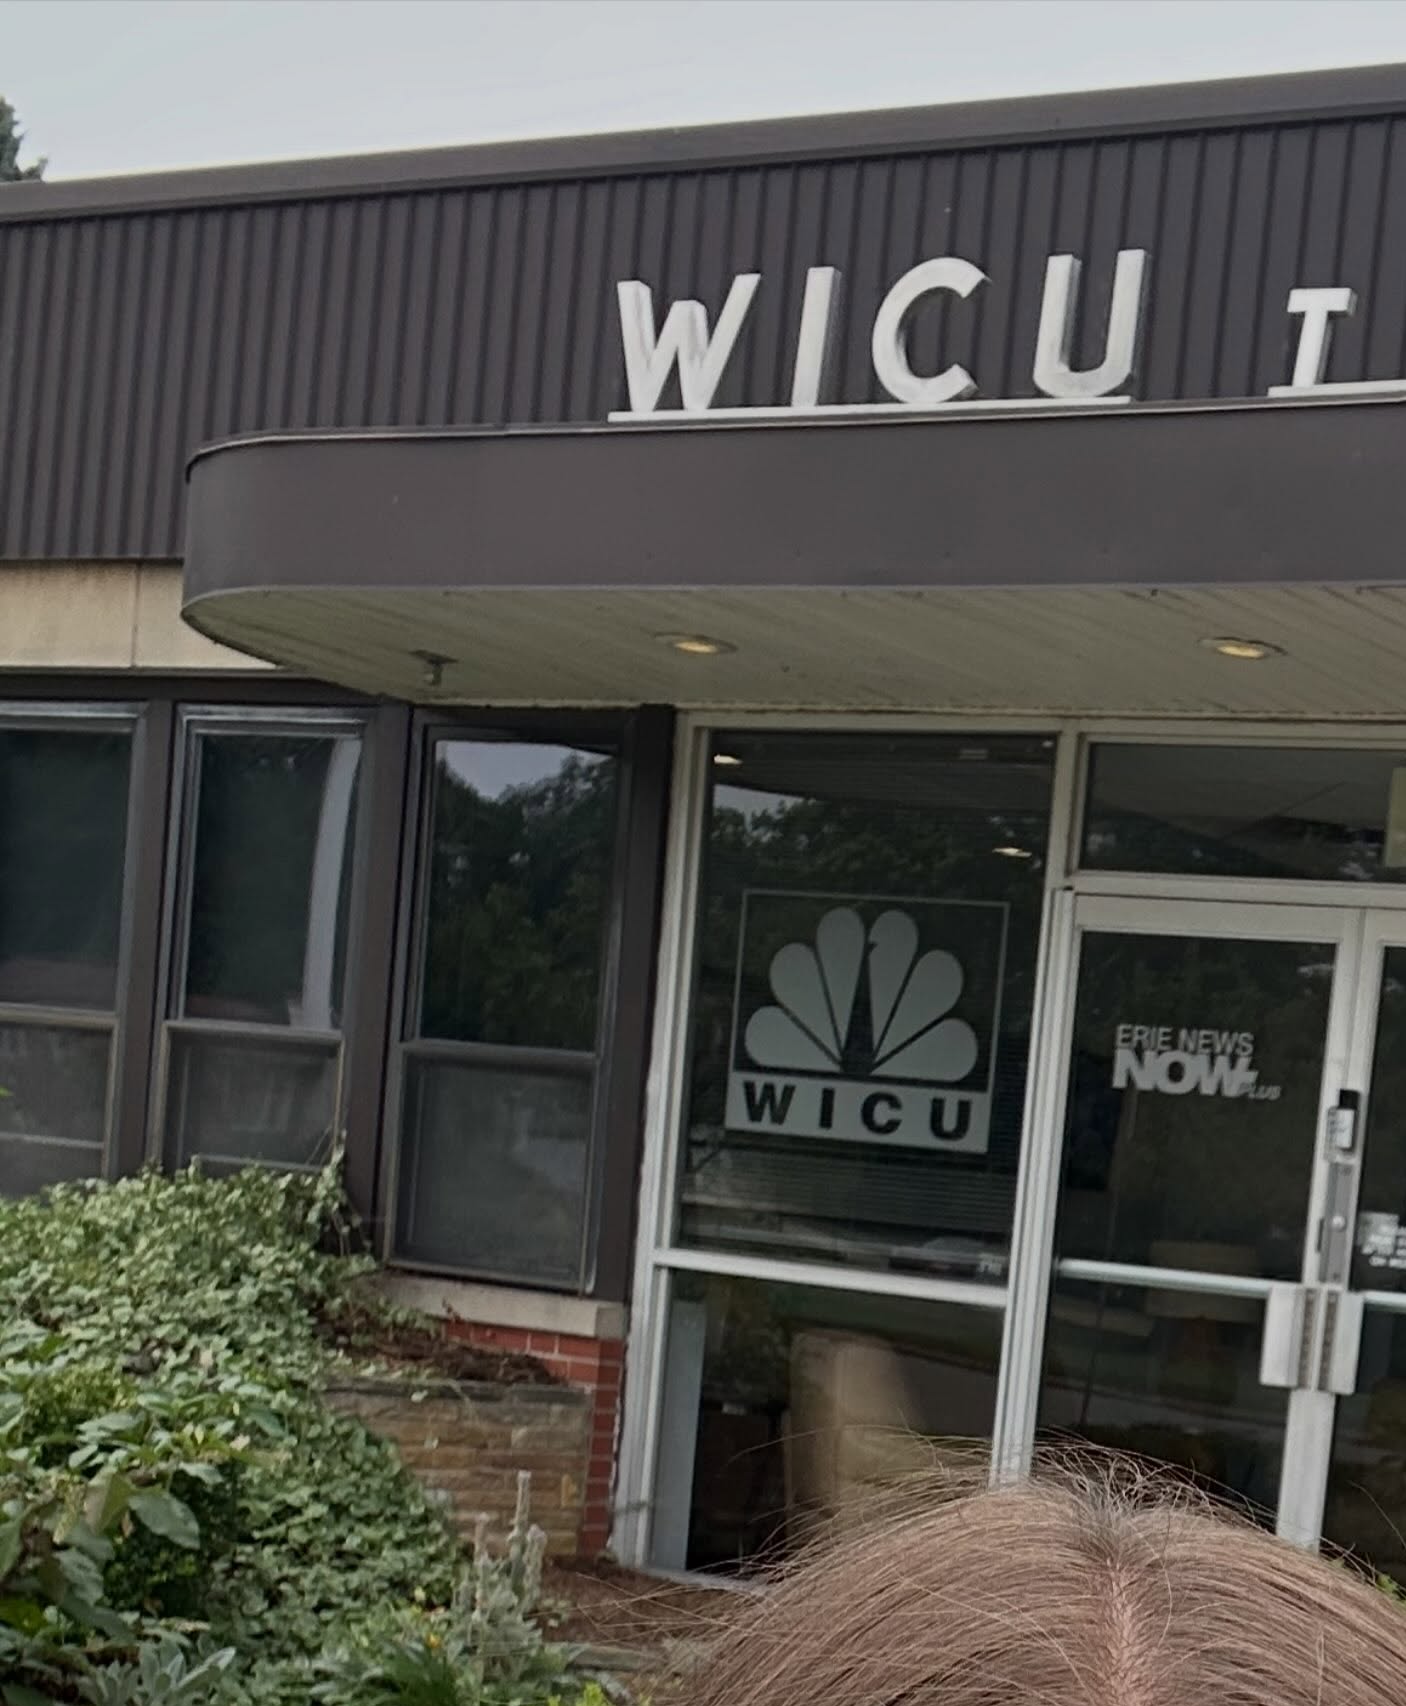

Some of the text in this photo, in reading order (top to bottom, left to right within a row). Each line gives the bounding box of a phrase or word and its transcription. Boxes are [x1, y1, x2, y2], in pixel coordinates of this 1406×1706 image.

[616, 248, 1147, 414] WICU
[1115, 1023, 1255, 1057] ERIE NEWS
[1112, 1047, 1256, 1098] NOW
[742, 1080, 972, 1142] WICU
